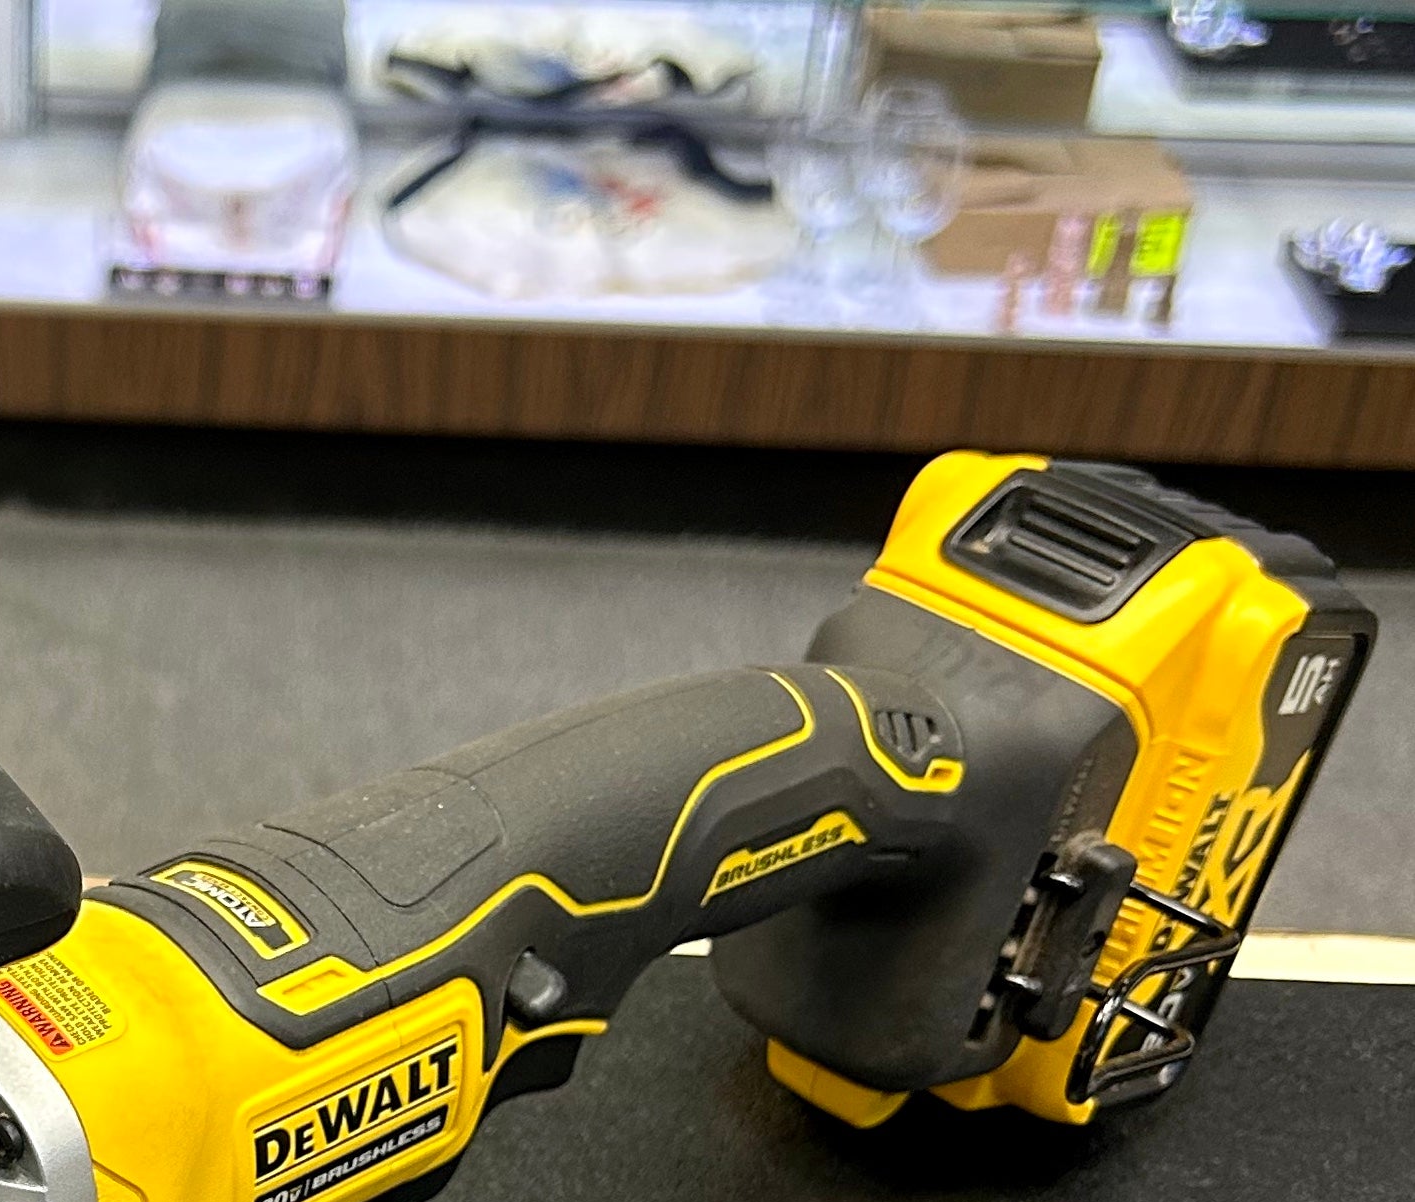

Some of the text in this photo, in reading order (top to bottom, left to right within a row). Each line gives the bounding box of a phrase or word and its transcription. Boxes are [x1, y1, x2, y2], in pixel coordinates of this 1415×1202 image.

[716, 823, 844, 888] BRUSHLESS
[1149, 790, 1238, 953] DWALT
[181, 876, 267, 928] ATOMIC
[29, 961, 106, 1037] WEAR EYE PROTECTION
[37, 958, 68, 984] REMOVE
[70, 976, 84, 987] OR
[81, 986, 111, 1014] BLADES
[23, 969, 96, 1041] HOLD SAW WITH BOTH
[29, 988, 65, 1022] GUARDING
[62, 1022, 87, 1045] CHECK
[255, 1043, 457, 1179] DEWALT
[311, 1114, 441, 1190] BRUSHLESS
